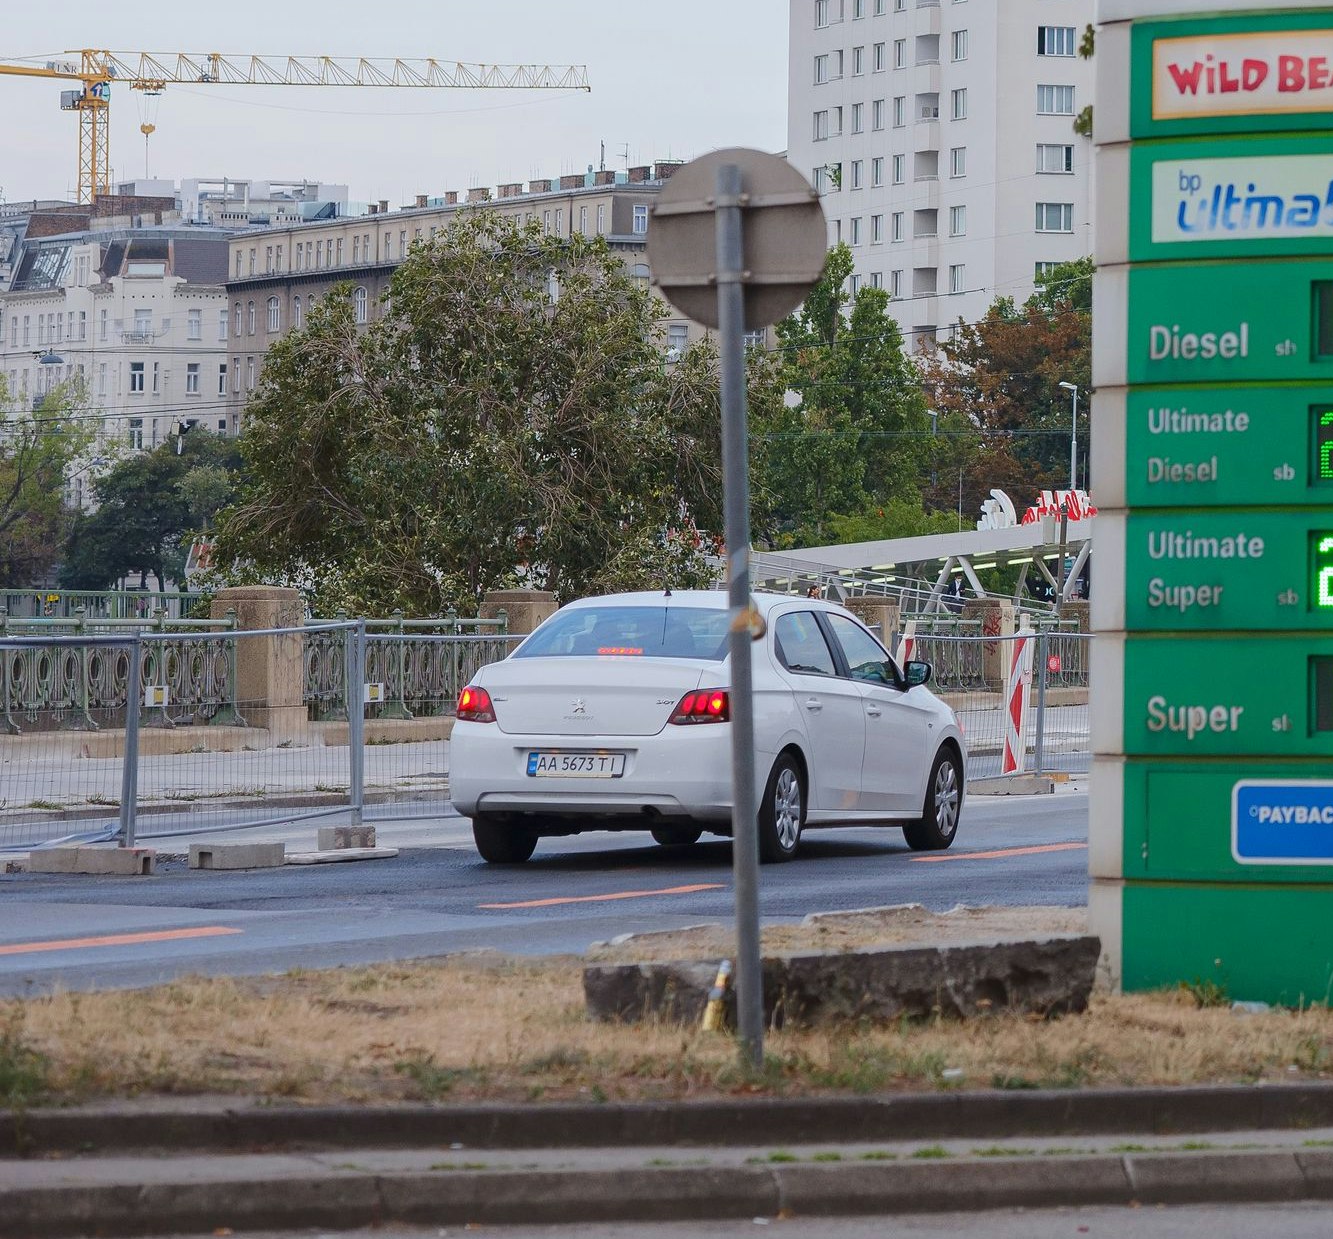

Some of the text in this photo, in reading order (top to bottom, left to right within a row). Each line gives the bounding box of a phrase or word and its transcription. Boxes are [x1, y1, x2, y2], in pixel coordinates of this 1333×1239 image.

[1178, 169, 1201, 194] bp
[1149, 322, 1249, 361] Diesel
[1147, 407, 1249, 434] Ultimate
[1147, 455, 1218, 484] Diesel
[1147, 531, 1265, 559] Ultimate
[1147, 578, 1224, 613] Super
[1146, 696, 1245, 740] Super
[537, 757, 558, 771] AA
[562, 757, 595, 772] 5673
